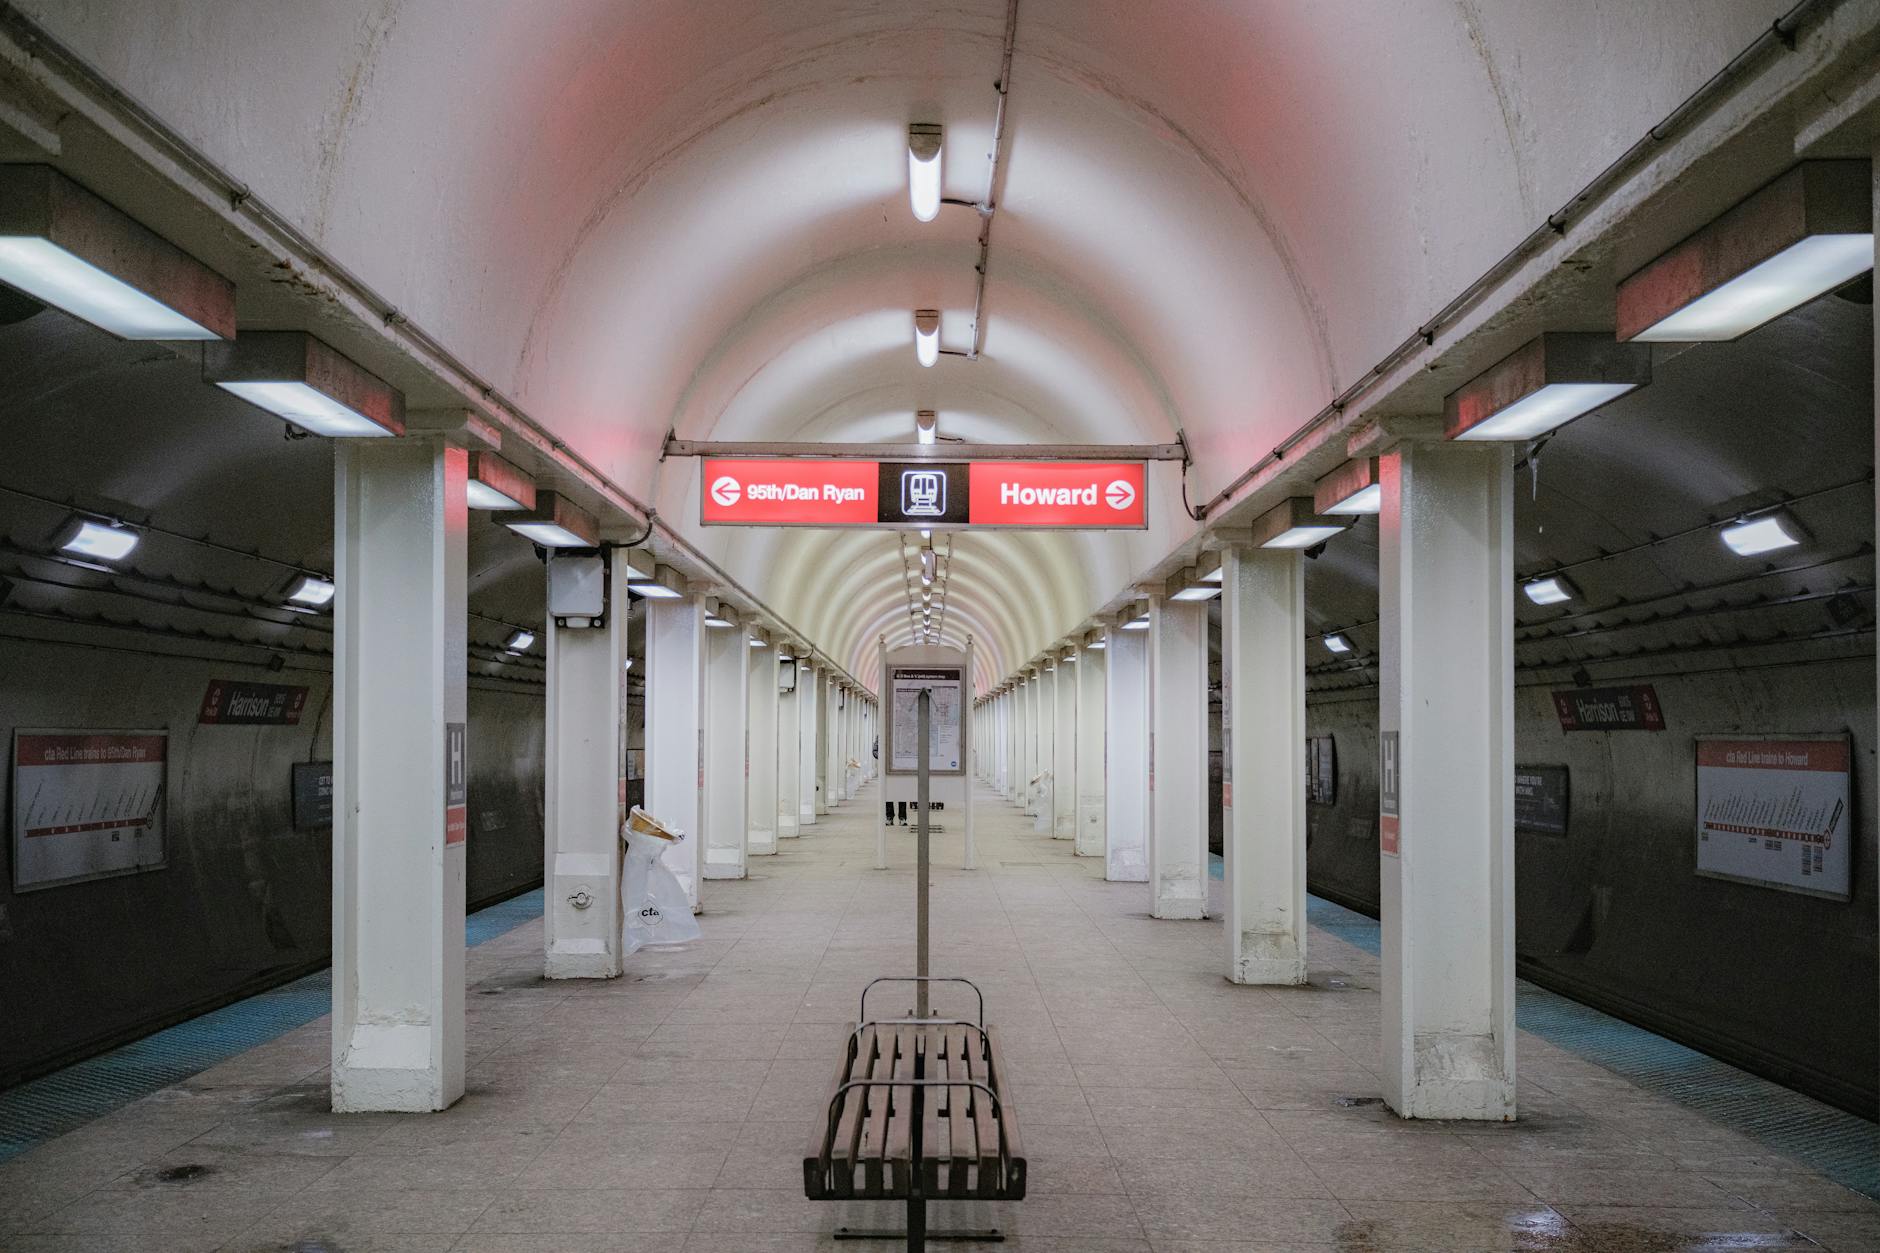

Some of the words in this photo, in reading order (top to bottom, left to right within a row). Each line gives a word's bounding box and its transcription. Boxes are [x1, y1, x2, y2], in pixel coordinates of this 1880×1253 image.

[747, 484, 820, 501] 95th/Dan
[822, 484, 865, 504] Ryan
[1000, 483, 1097, 506] Howard
[227, 690, 269, 717] Harrison
[1576, 697, 1619, 722] Harrison
[57, 747, 69, 760] Red
[70, 747, 83, 760] Line
[83, 747, 99, 760] trains
[100, 748, 107, 759] to
[132, 746, 146, 760] Ryan
[451, 731, 462, 785] H
[1736, 751, 1747, 763] Red
[1748, 752, 1760, 764] Line
[1760, 752, 1777, 765] trains
[1778, 753, 1784, 765] to
[1785, 753, 1808, 766] Howard
[1384, 740, 1394, 793] H
[641, 907, 660, 917] cta
